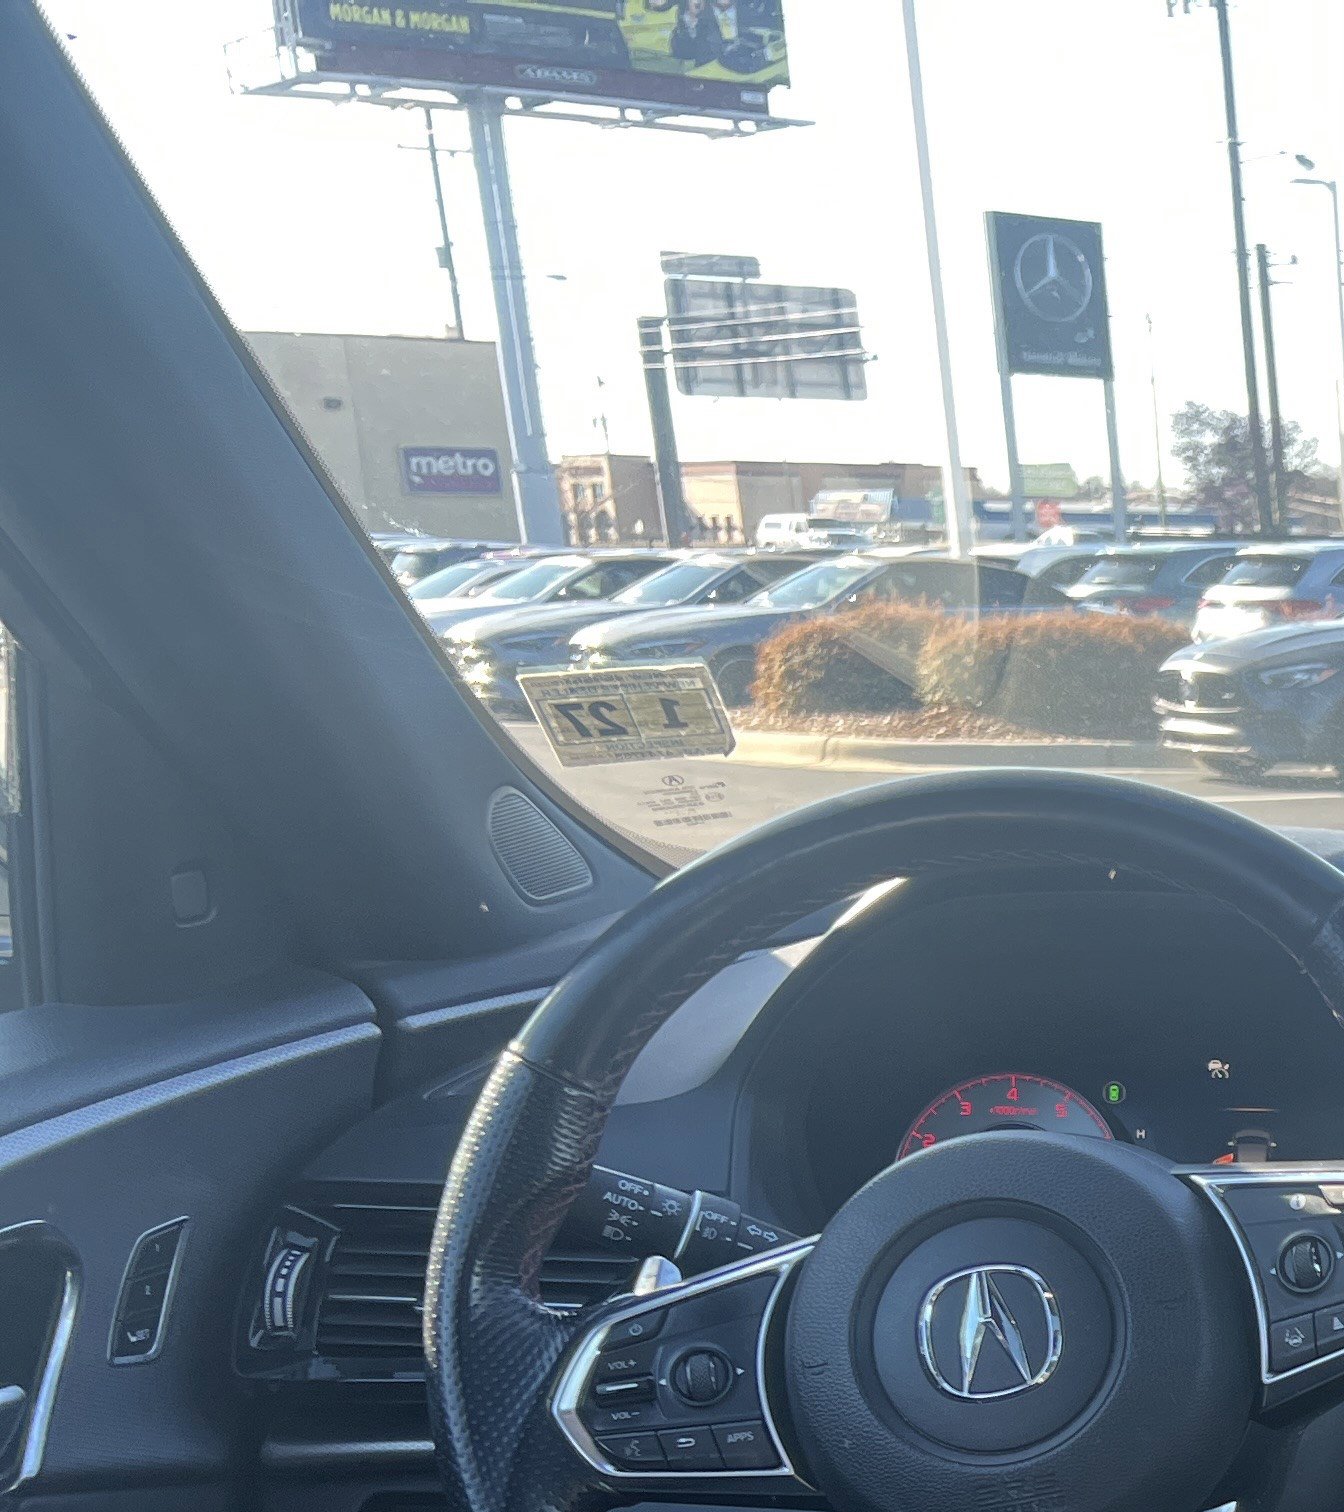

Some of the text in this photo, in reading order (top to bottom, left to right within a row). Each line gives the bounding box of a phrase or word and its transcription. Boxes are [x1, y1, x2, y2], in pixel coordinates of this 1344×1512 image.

[329, 4, 391, 26] MORGAN
[395, 10, 406, 28] &
[409, 11, 471, 34] MORGAN
[409, 452, 496, 477] metro
[1006, 1087, 1019, 1101] 4
[960, 1101, 972, 1116] 3
[1055, 1103, 1068, 1118] 5
[922, 1133, 936, 1147] 2
[1136, 1129, 1146, 1139] H
[617, 1179, 644, 1194] OFF
[602, 1191, 639, 1210] AUTO
[727, 1431, 754, 1444] APPS
